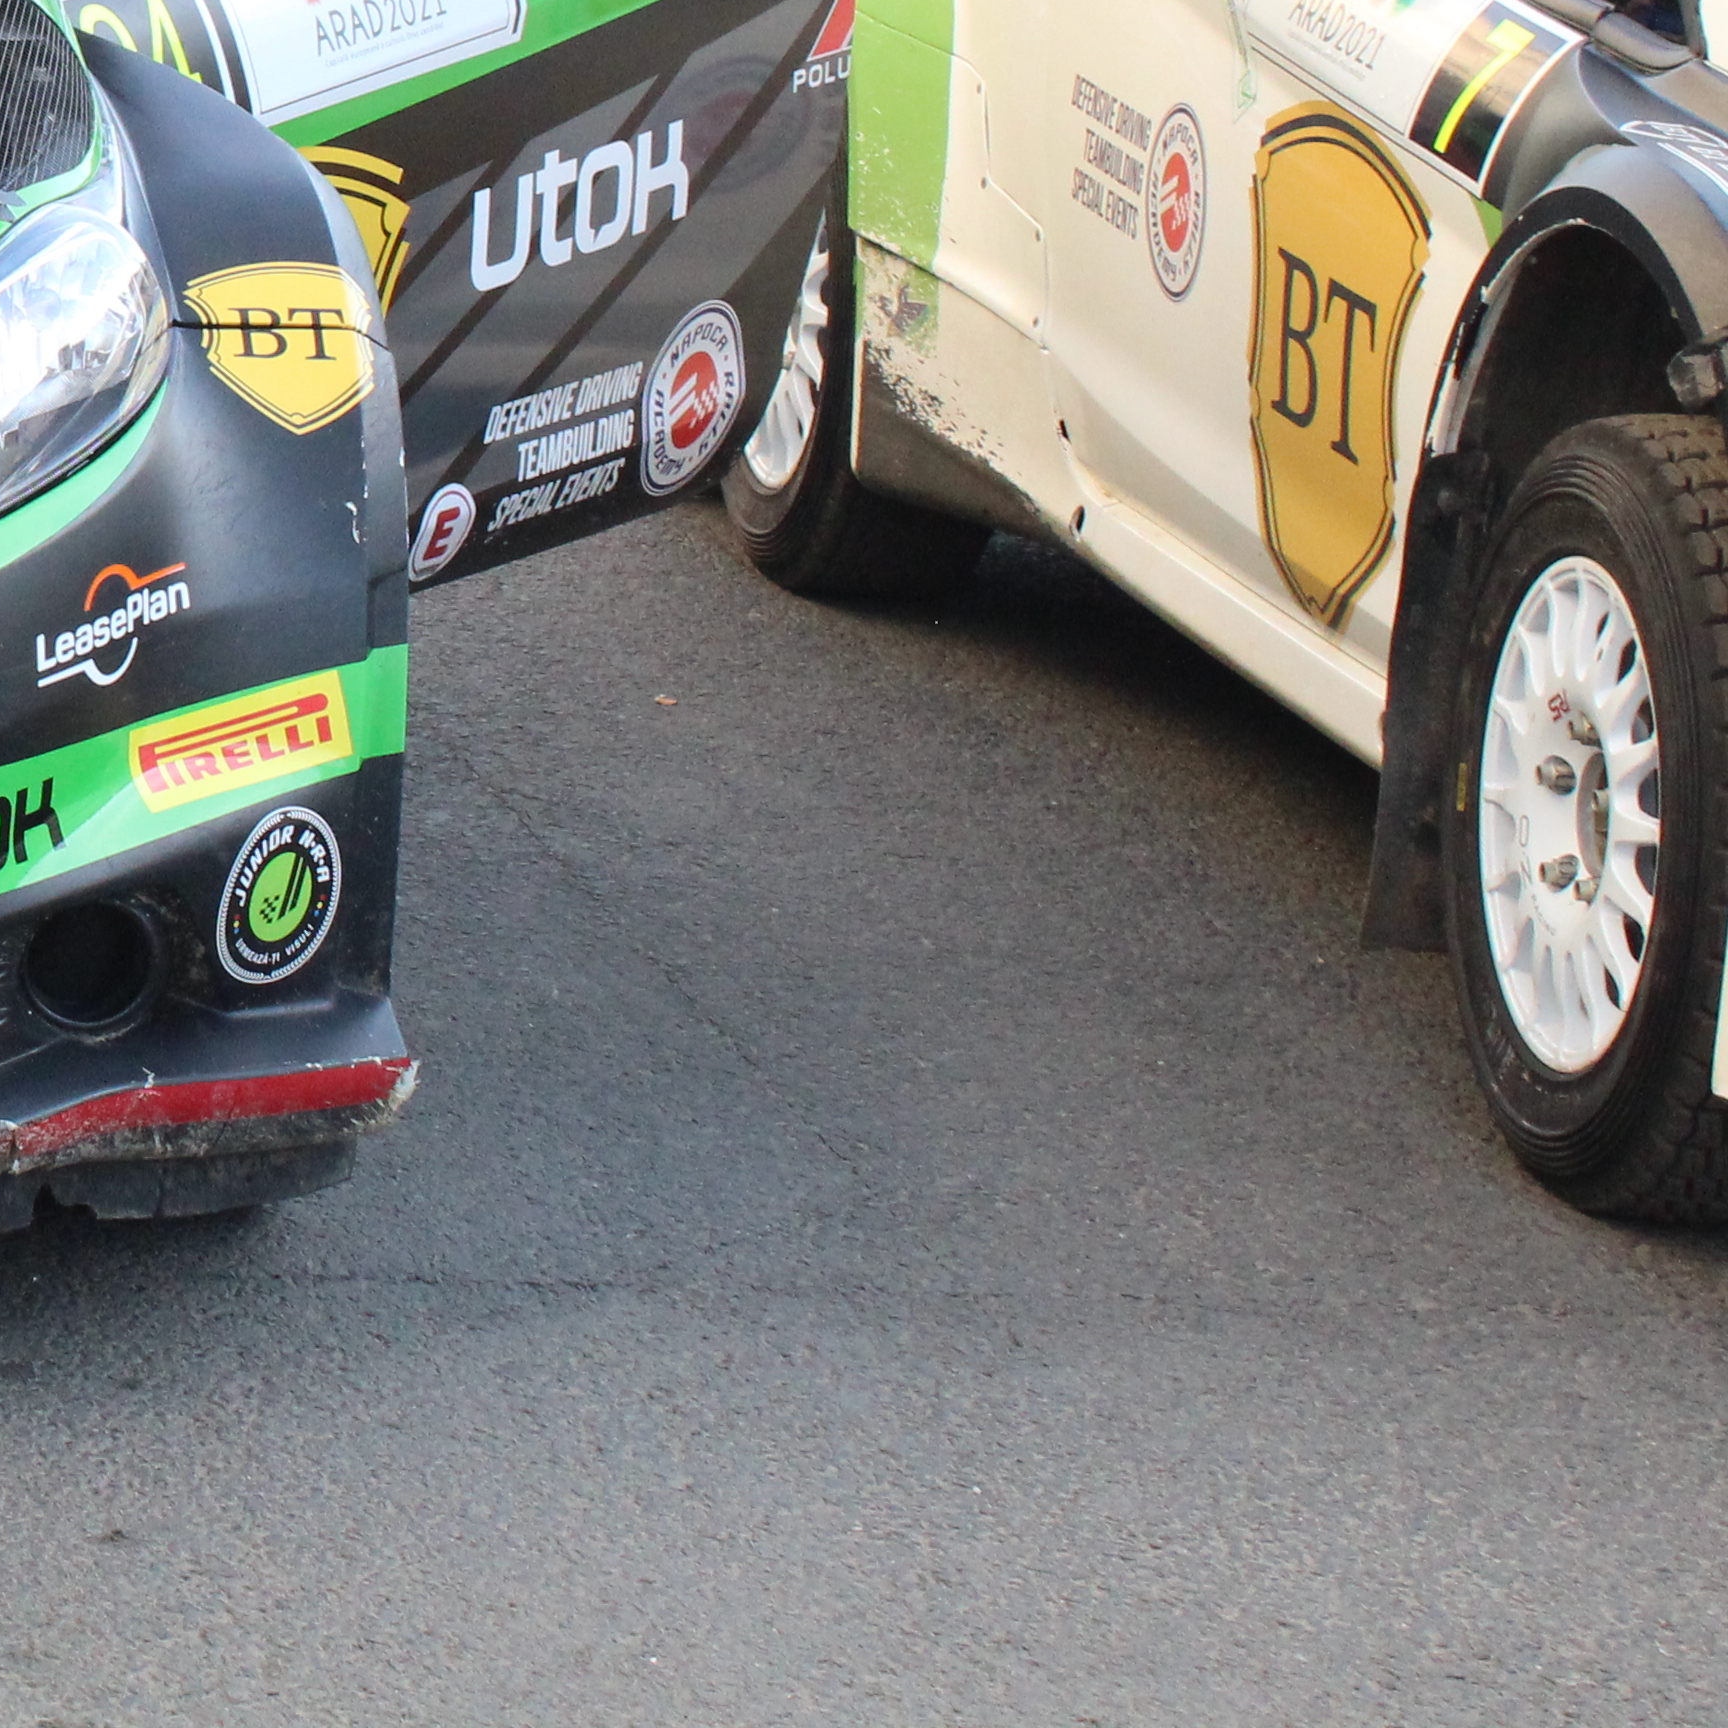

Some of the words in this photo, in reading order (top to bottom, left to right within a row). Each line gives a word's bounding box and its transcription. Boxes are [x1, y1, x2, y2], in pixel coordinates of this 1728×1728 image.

[793, 55, 851, 93] POLU
[1070, 73, 1119, 132] DEFENSIVE
[1114, 100, 1152, 152] DRIVING
[1433, 19, 1535, 155] 7
[1083, 127, 1145, 197] TEAMBUILDING
[1161, 122, 1200, 168] NAPOCA
[1071, 167, 1105, 218] SPECIAL
[1104, 189, 1140, 241] EVENTS
[227, 306, 344, 364] BT
[670, 323, 728, 369] NAPOCA
[1270, 247, 1379, 468] BT
[483, 385, 577, 445] DEFENSIVE
[574, 361, 644, 415] DRIVING
[652, 388, 685, 475] ACADEMY
[697, 370, 735, 459] RALLY
[517, 408, 636, 483] TEAMBUILDING
[421, 506, 461, 561] E
[488, 481, 557, 532] SPECIAL
[554, 458, 626, 510] EVENTS
[36, 579, 190, 673] LeasePlan
[138, 692, 334, 793] PIRELLI
[234, 825, 295, 908] JUNIOR
